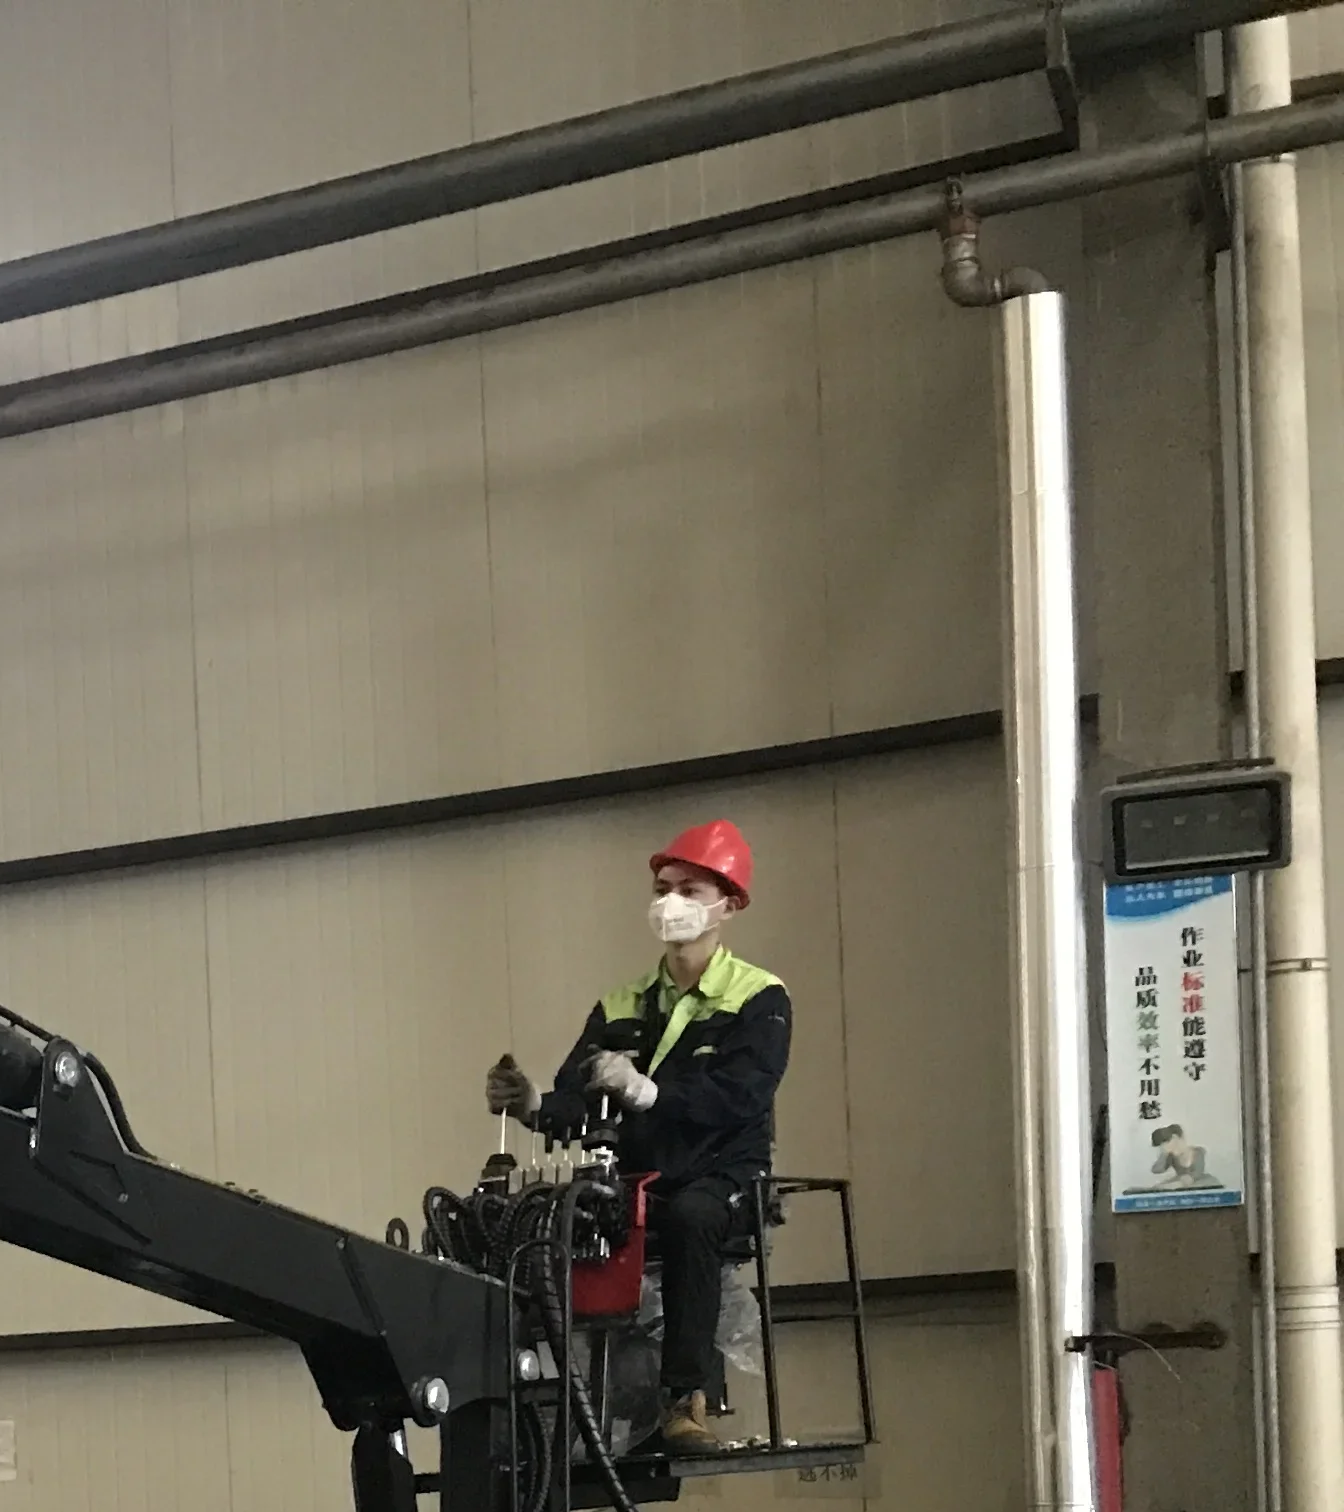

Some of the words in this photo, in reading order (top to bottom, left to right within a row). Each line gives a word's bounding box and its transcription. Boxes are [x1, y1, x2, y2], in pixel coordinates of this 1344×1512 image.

[1134, 966, 1162, 1120] 品质效率不用愁
[1180, 926, 1206, 1082] 作业标准能遵守
